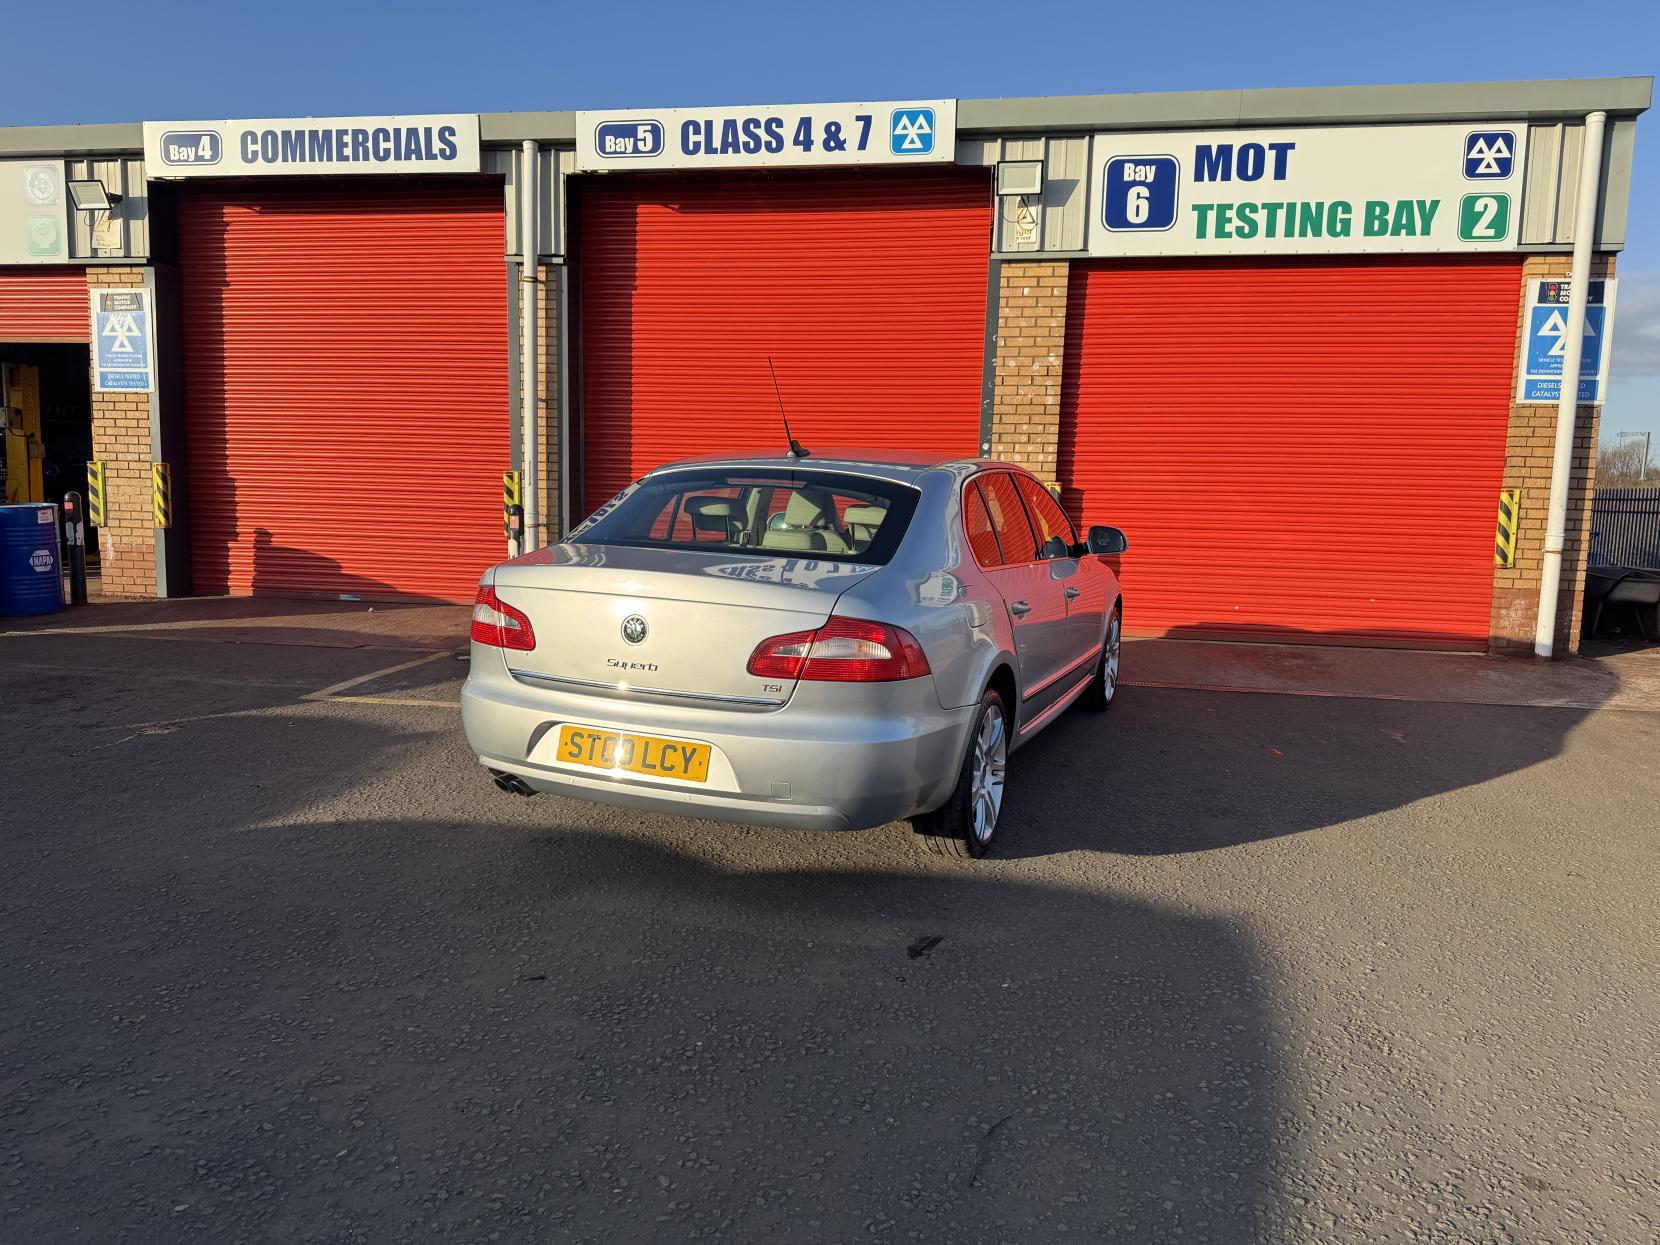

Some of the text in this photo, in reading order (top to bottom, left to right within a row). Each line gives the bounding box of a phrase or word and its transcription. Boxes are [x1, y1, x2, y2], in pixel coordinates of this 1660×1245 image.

[169, 135, 213, 161] Bay 4
[240, 125, 458, 164] COMMERCIALS
[604, 125, 653, 154] Bay 5
[680, 114, 873, 156] CLASS 4 & 7
[1123, 162, 1156, 183] Bay
[1193, 142, 1296, 183] MOT
[1126, 185, 1150, 225] 6
[1191, 199, 1441, 240] TESTING BAY
[1471, 196, 1499, 237] 2
[33, 555, 51, 567] NAPA
[606, 658, 659, 672] Superb
[762, 683, 783, 693] TSI
[640, 740, 697, 775] LCY
